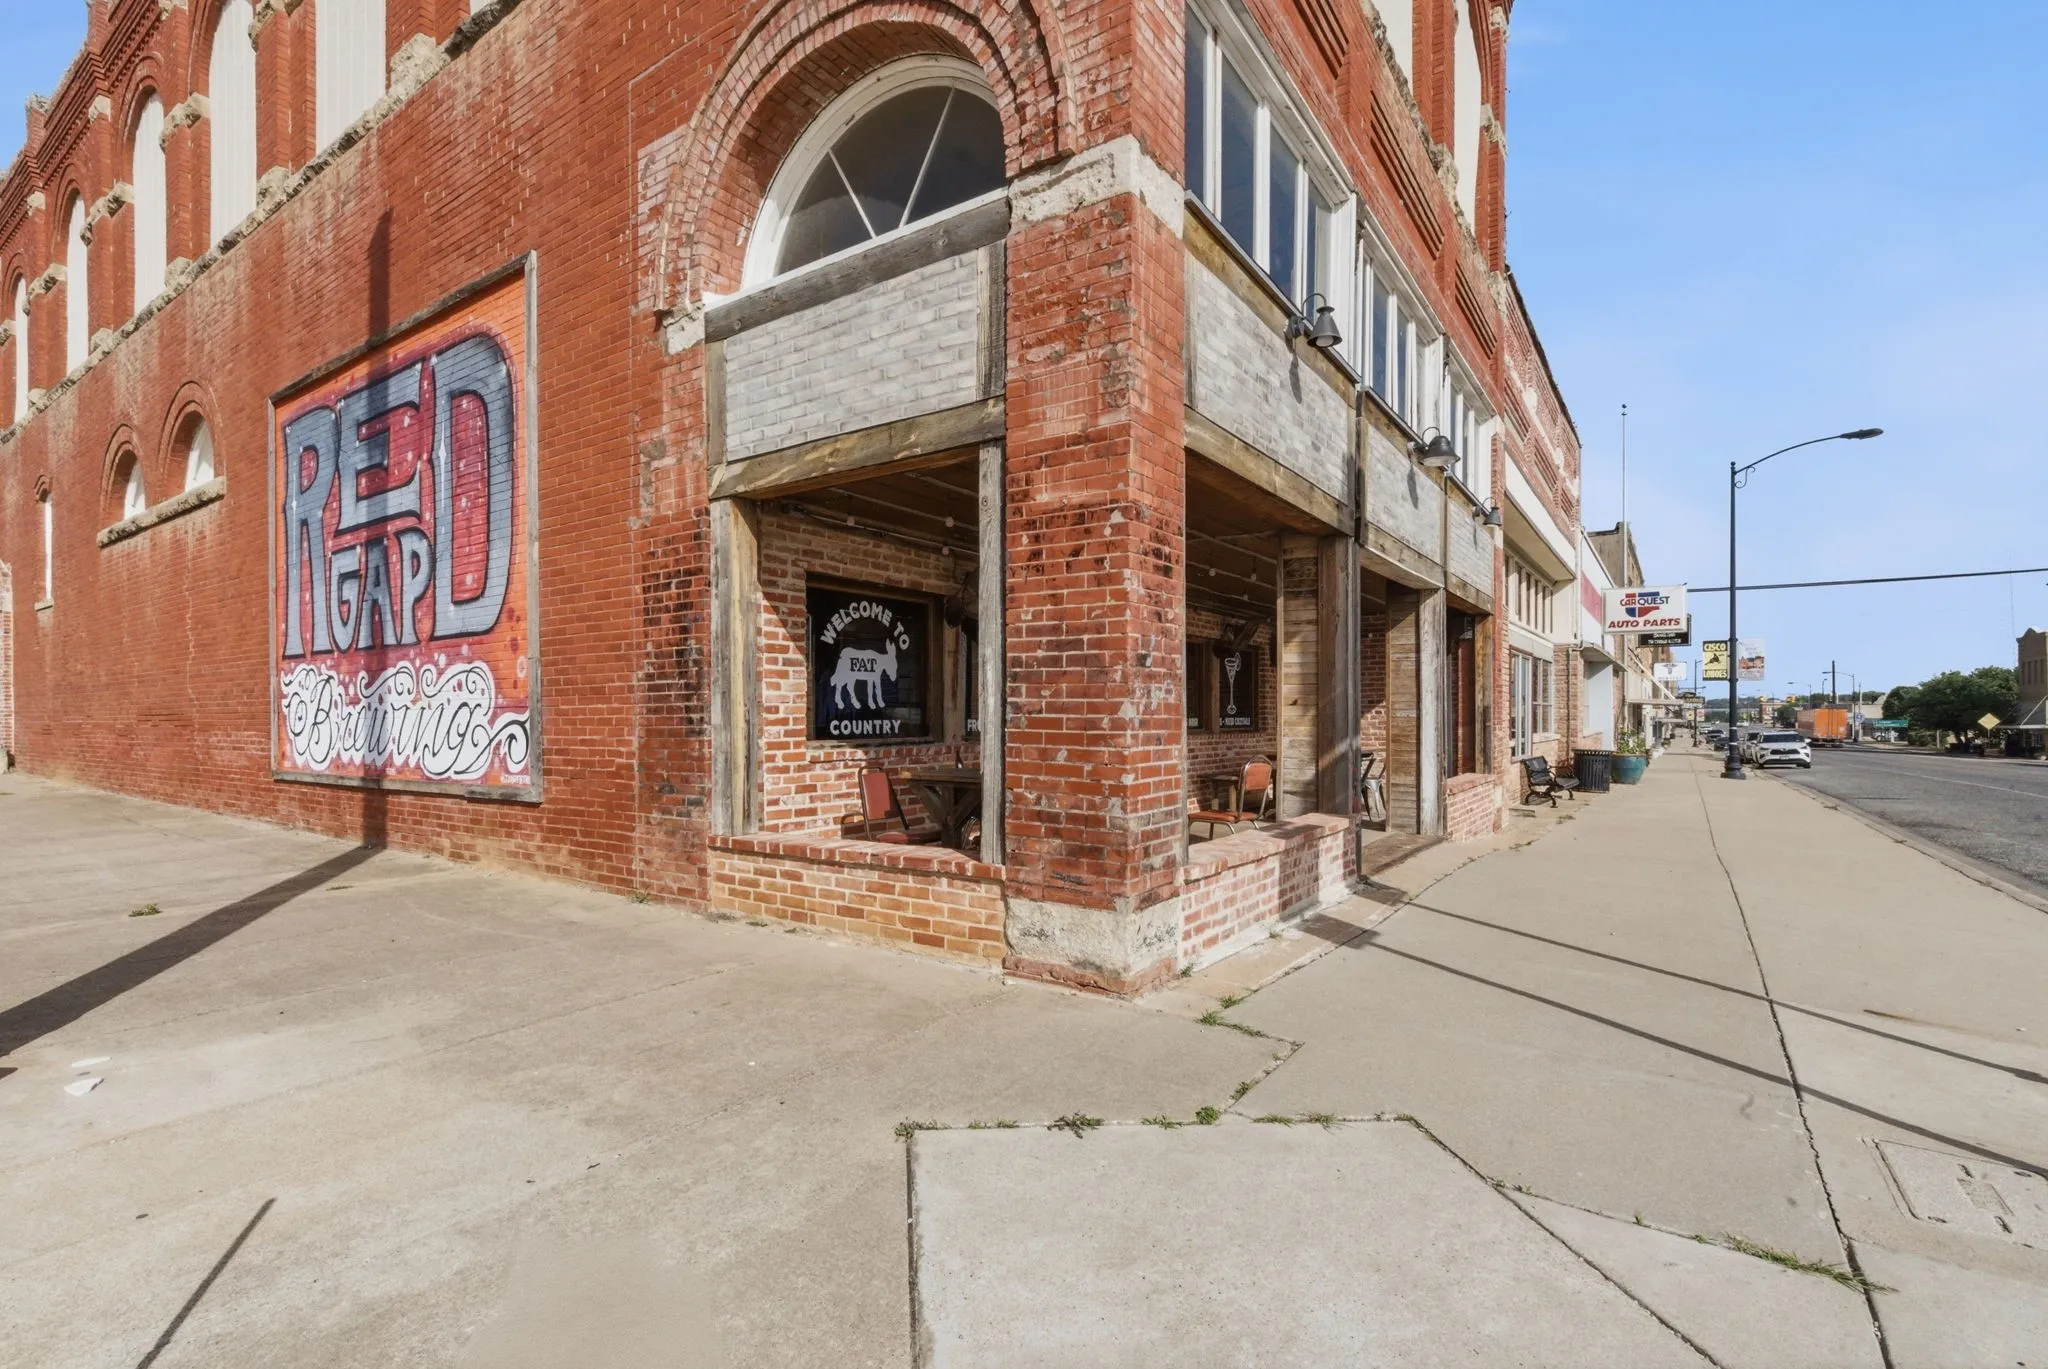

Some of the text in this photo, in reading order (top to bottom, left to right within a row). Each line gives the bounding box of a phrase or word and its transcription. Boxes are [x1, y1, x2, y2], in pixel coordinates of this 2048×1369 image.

[282, 333, 514, 659] RED
[328, 527, 433, 651] GAP
[820, 601, 910, 650] WELCOME TO
[1608, 617, 1681, 629] AUTO PARTS
[1704, 643, 1727, 651] CISCO
[850, 658, 877, 673] FAT
[283, 666, 529, 776] Brewing
[830, 719, 901, 736] COUNTRY
